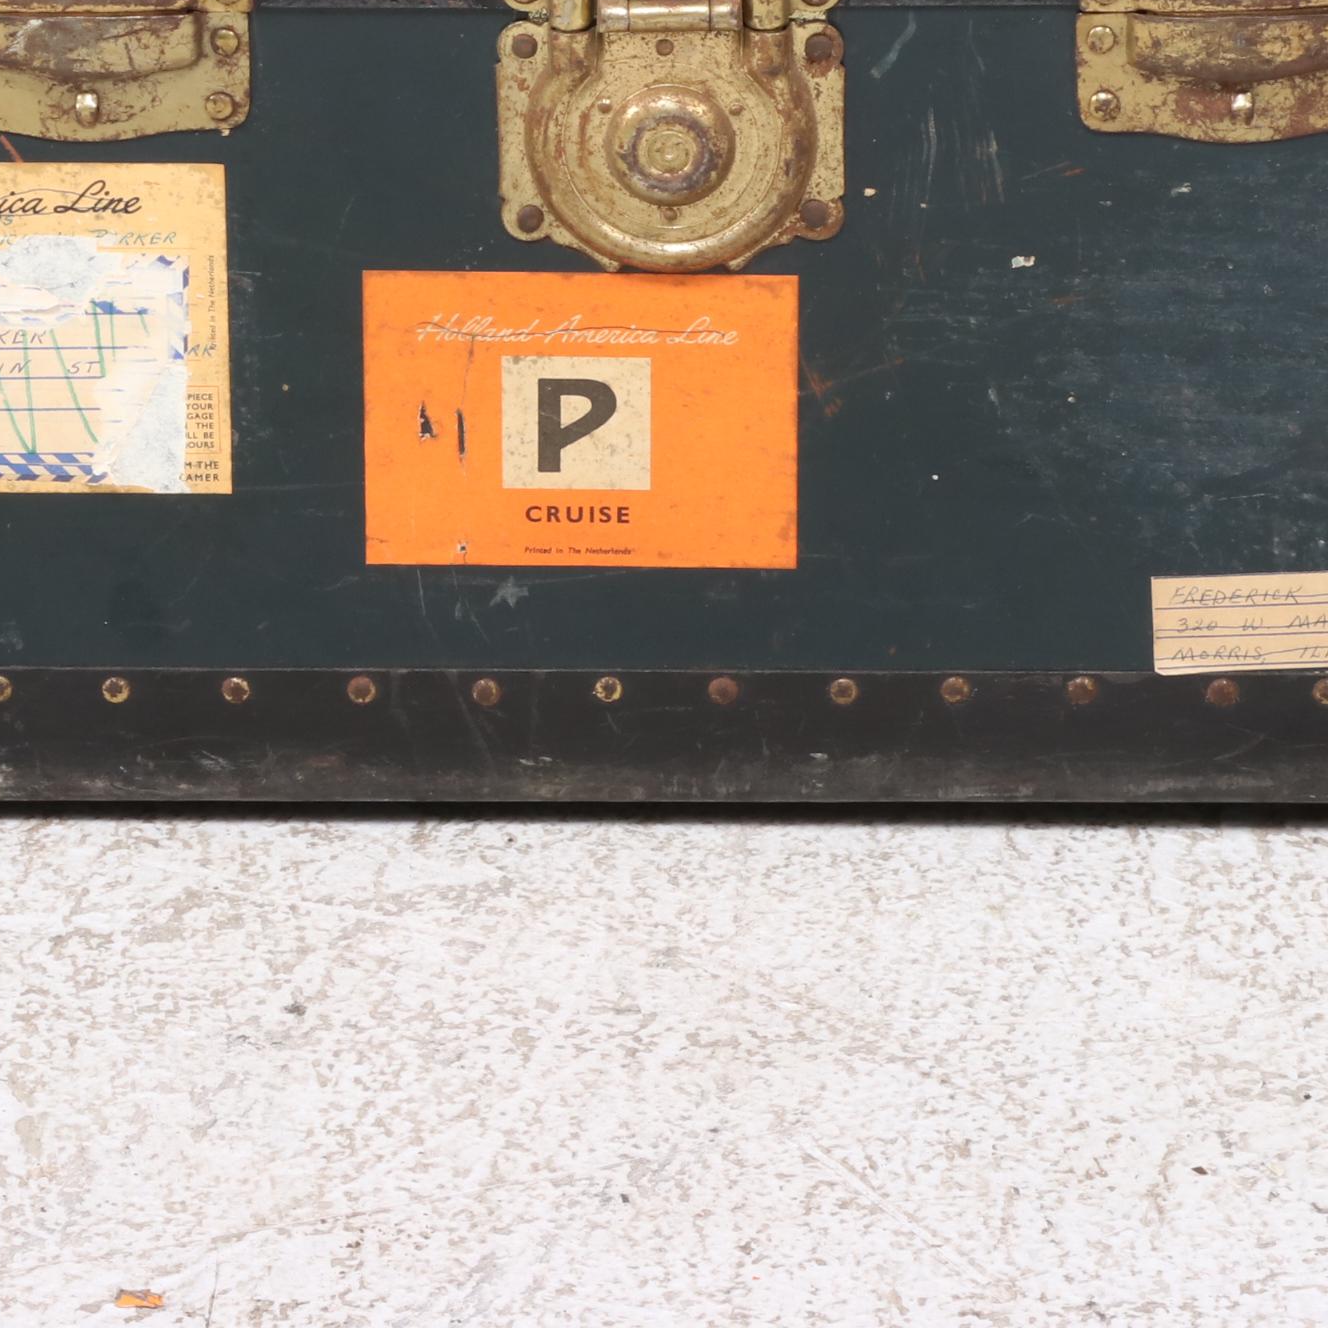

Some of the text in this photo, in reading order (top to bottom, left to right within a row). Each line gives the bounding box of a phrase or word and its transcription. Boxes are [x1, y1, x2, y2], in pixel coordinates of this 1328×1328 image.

[53, 179, 143, 215] Line
[416, 312, 739, 346] Holland-America Line
[67, 361, 102, 374] ST
[186, 402, 214, 411] YOUR
[196, 422, 214, 430] THE
[537, 378, 618, 473] P
[203, 431, 214, 440] BE
[186, 441, 215, 449] OURS
[196, 460, 220, 470] THE
[525, 505, 631, 524] CRUISE
[524, 546, 553, 555] Printed
[568, 546, 582, 554] The
[1171, 585, 1303, 606] FREDERICK
[1177, 617, 1218, 633] 320
